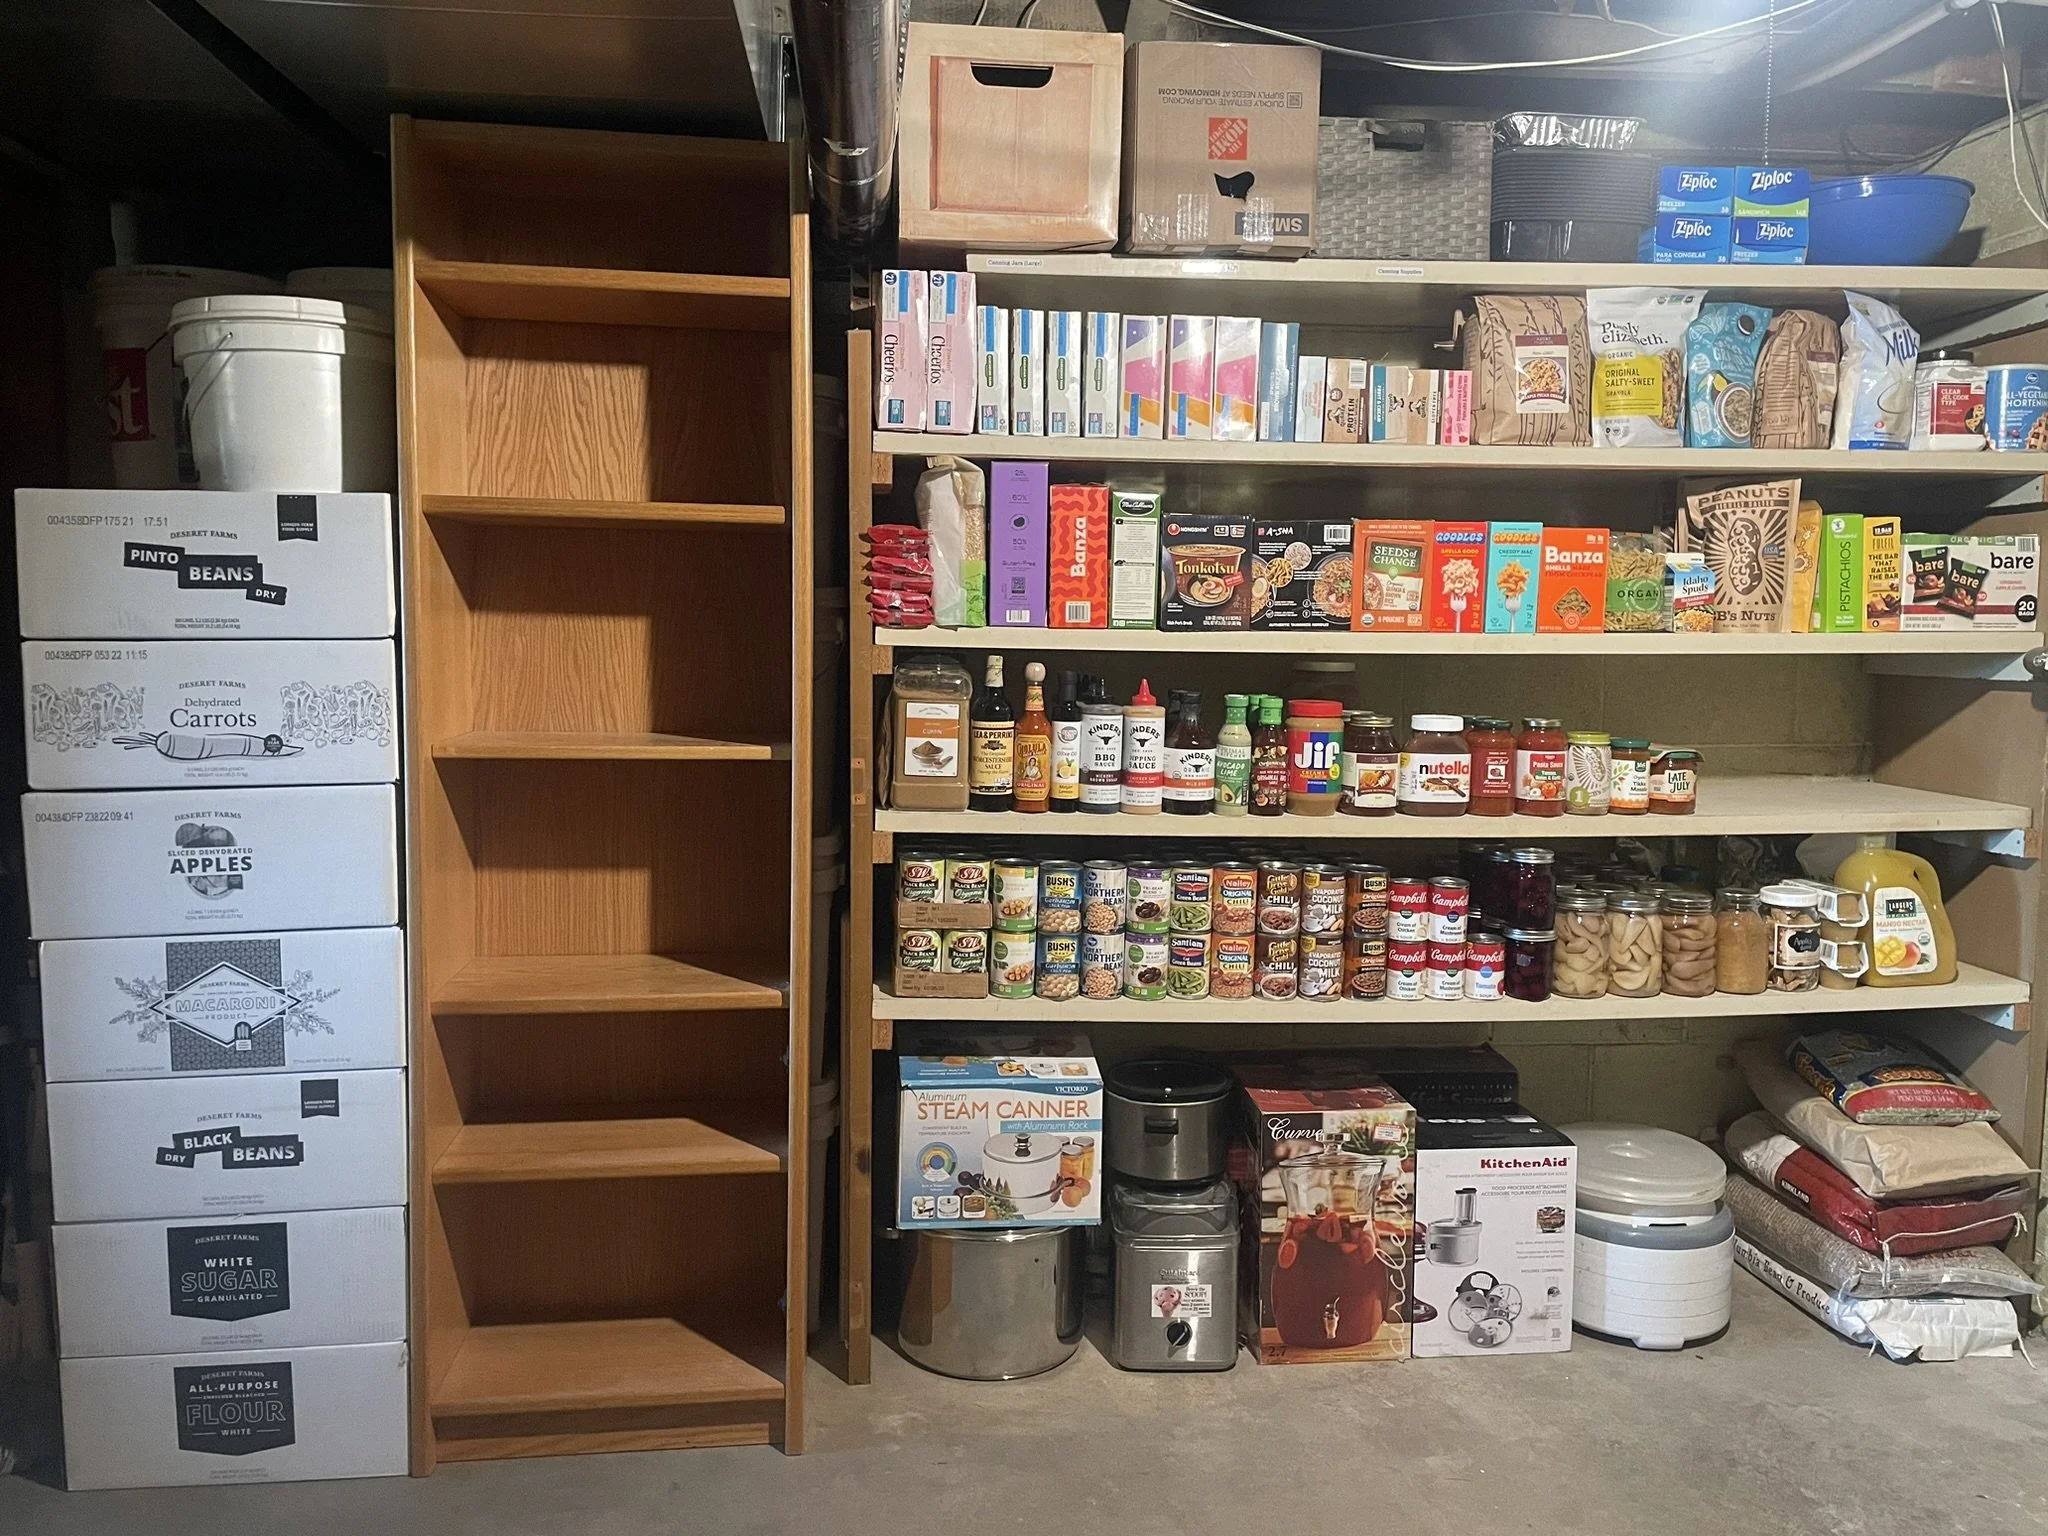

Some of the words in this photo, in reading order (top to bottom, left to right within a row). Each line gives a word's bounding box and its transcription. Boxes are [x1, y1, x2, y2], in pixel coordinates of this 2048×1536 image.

[1158, 87, 1221, 98] HDMOVING.COM
[1233, 91, 1255, 100] NEEDS
[1257, 92, 1284, 101] SUPPLY
[1162, 96, 1194, 106] PACKING
[1196, 97, 1217, 106] YOUR
[1219, 98, 1252, 107] ESTIMATE
[1254, 99, 1285, 108] QUICKLY
[1682, 174, 1718, 192] Ziploc
[1751, 170, 1793, 193] Ziploc
[1675, 219, 1712, 239] Ziploc
[1759, 222, 1794, 240] Ziploc
[1882, 328, 1919, 367] Milk
[884, 334, 898, 383] Cheerios
[931, 336, 946, 385] Cheerios
[1607, 351, 1633, 360] ORGANIC
[1605, 368, 1640, 378] ORIGINAL
[1605, 377, 1655, 388] SALTY-SWEET
[1606, 389, 1631, 397] GRANOLA
[1346, 398, 1355, 434] PROTEIN
[1698, 486, 1790, 508] PEANUTS
[104, 516, 121, 526] 175
[143, 516, 168, 527] 17:51
[170, 530, 208, 541] DESERET
[210, 530, 239, 541] FARMS
[1266, 528, 1293, 536] A-SHA
[1436, 532, 1486, 543] GOODLES
[1492, 532, 1540, 544] GOODLES
[1070, 516, 1087, 578] Banza
[1375, 545, 1410, 558] SEEDS
[1410, 549, 1418, 559] of
[1763, 546, 1778, 554] USA
[131, 549, 180, 565] PINTO
[1545, 546, 1604, 564] Banza
[1990, 552, 2035, 570] bare
[1176, 560, 1235, 575] Tonkotsu
[1373, 555, 1416, 568] CHANGE
[1915, 558, 1945, 573] bare
[189, 565, 255, 582] BEANS
[1839, 541, 1850, 612] PISTACHIOS
[1951, 570, 1980, 589] bare
[1683, 574, 1709, 586] Idaho
[255, 588, 278, 600] DRY
[1682, 583, 1709, 596] Spuds
[2018, 601, 2035, 611] 20
[1382, 616, 1405, 624] POUCHES
[126, 649, 149, 661] 11:15
[179, 681, 219, 691] DESERET
[219, 680, 248, 690] FARMS
[185, 697, 242, 708] Dehydrated
[169, 708, 258, 729] Carrots
[1095, 753, 1116, 762] BBQ
[1295, 741, 1341, 769] Jif
[1128, 762, 1157, 770] SAUCE
[1216, 762, 1245, 770] AVOCADO
[1419, 761, 1470, 776] nutella
[1220, 769, 1238, 777] LIME
[1668, 772, 1687, 785] LATE
[1669, 781, 1691, 794] JULY
[1576, 790, 1585, 802] 1
[174, 810, 212, 822] DESERET
[213, 810, 243, 821] FARMS
[167, 848, 197, 857] SLICED
[198, 846, 254, 857] DEHYDRATED
[169, 855, 254, 875] APPLES
[1175, 873, 1209, 884] Santiam
[1225, 879, 1252, 890] Nalley
[1222, 889, 1252, 898] ORIGINAL
[1311, 895, 1344, 904] COCONUT
[1267, 896, 1294, 905] CHILI
[1323, 904, 1344, 914] MILK
[1876, 920, 1902, 928] MANGO
[1902, 919, 1928, 927] NECTAR
[1171, 938, 1204, 949] Santiam
[1221, 944, 1249, 955] Nalley
[1171, 959, 1188, 967] Green
[1188, 959, 1202, 967] Beans
[1218, 954, 1249, 962] ORIGINAL
[1308, 958, 1341, 967] COCONUT
[1222, 963, 1246, 971] CHILI
[1269, 962, 1295, 971] CHILI
[1319, 967, 1341, 978] MILK
[1475, 982, 1497, 990] Tomato
[175, 995, 277, 1013] MACARONI
[205, 1012, 248, 1020] PRODUCT
[918, 1091, 967, 1102] Aluminum
[917, 1101, 989, 1120] STEAM
[996, 1100, 1090, 1119] CANNER
[196, 1113, 233, 1123] DESERET
[235, 1112, 264, 1122] FARMS
[1007, 1122, 1023, 1130] with
[1023, 1121, 1067, 1131] Aluminum
[1068, 1120, 1089, 1130] Rack
[1266, 1116, 1326, 1142] Curve
[183, 1132, 234, 1151] BLACK
[164, 1153, 187, 1165] DRY
[232, 1145, 296, 1163] BEANS
[1480, 1157, 1568, 1169] KitchenAid
[1781, 1179, 1810, 1203] KIRKLAND
[195, 1234, 231, 1245] DESERET
[232, 1233, 261, 1243] FARMS
[203, 1256, 254, 1268] WHITE
[181, 1268, 279, 1294] SUGAR
[1762, 1258, 1783, 1283] Bean
[1796, 1281, 1831, 1315] Produce
[197, 1292, 263, 1304] GRANULATED
[201, 1370, 237, 1381] DESERET
[238, 1369, 266, 1379] FARMS
[189, 1380, 280, 1394] ALL-PURPOSE
[185, 1400, 287, 1426] FLOUR
[220, 1428, 252, 1438] WHITE
